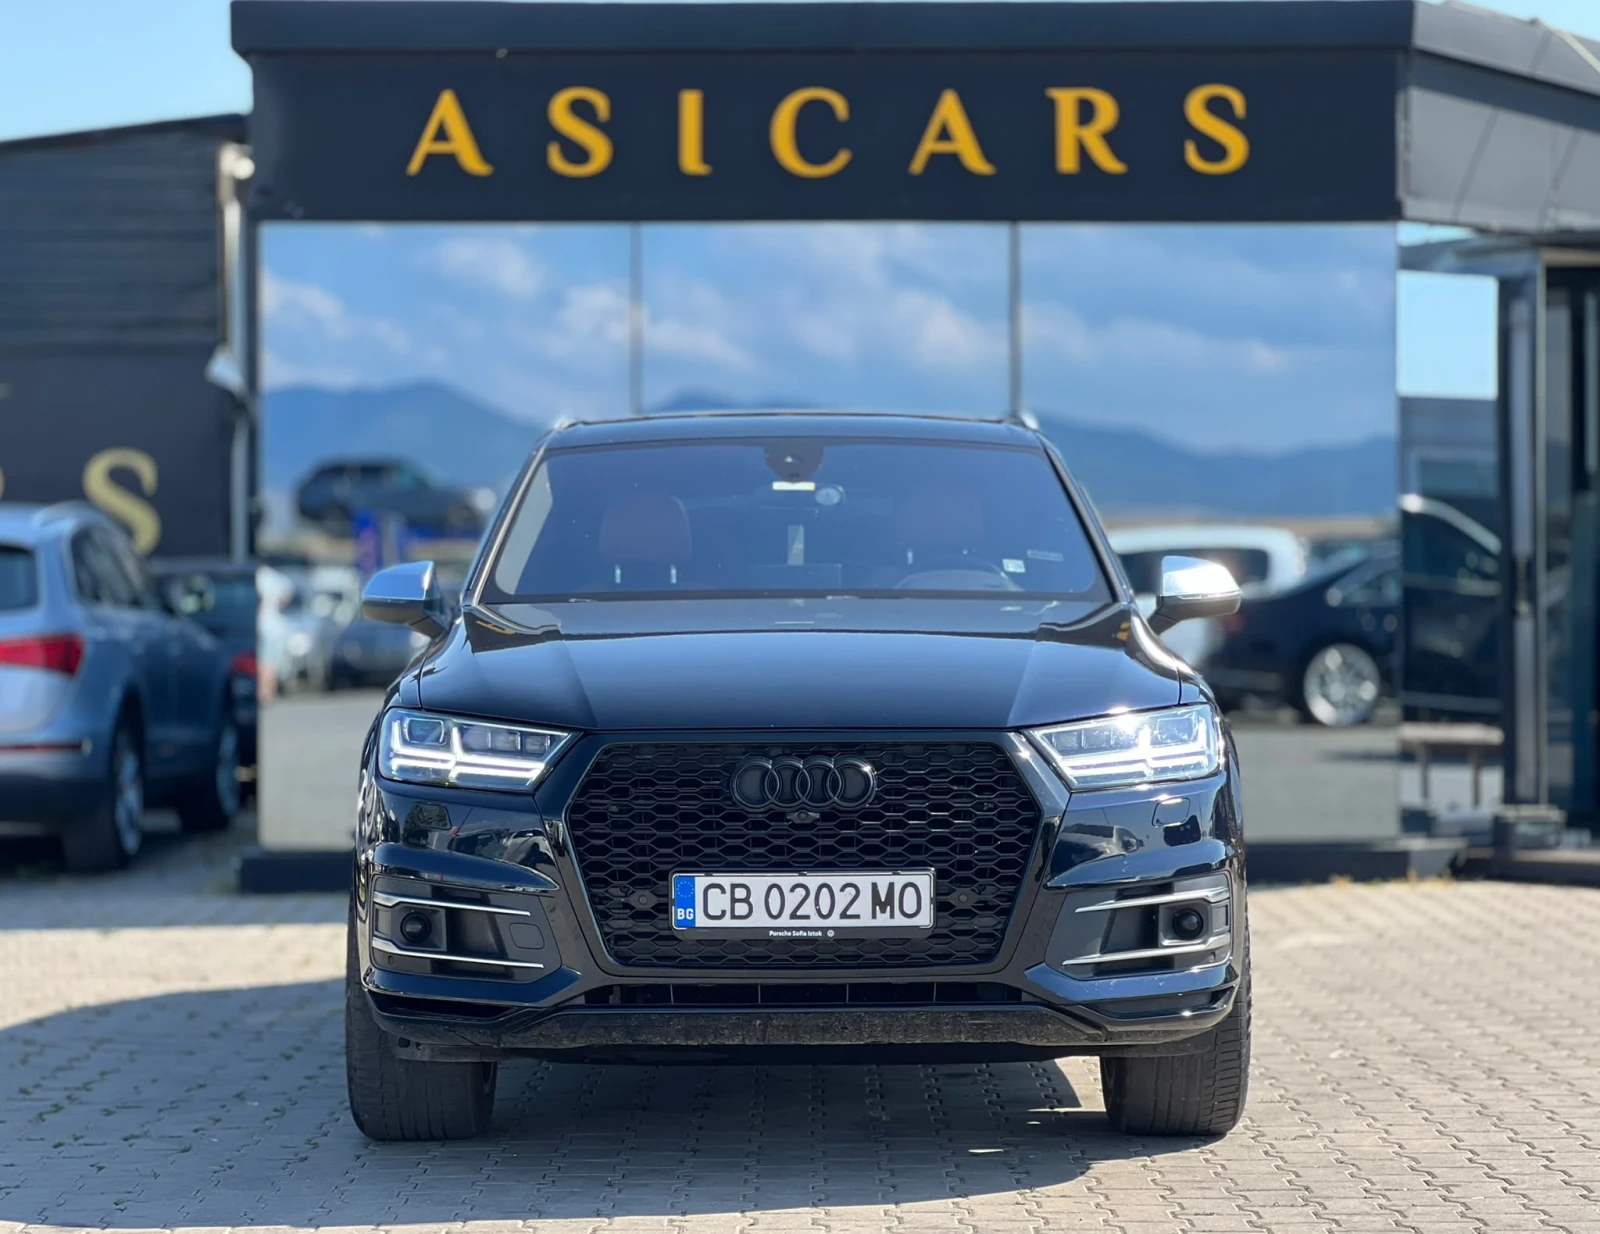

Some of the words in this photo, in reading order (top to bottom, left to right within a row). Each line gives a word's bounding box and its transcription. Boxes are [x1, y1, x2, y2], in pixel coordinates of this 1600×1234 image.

[407, 84, 1250, 177] ASICARS
[677, 908, 694, 920] BG
[702, 883, 754, 921] CB
[764, 883, 861, 920] 0202
[871, 882, 922, 919] MO
